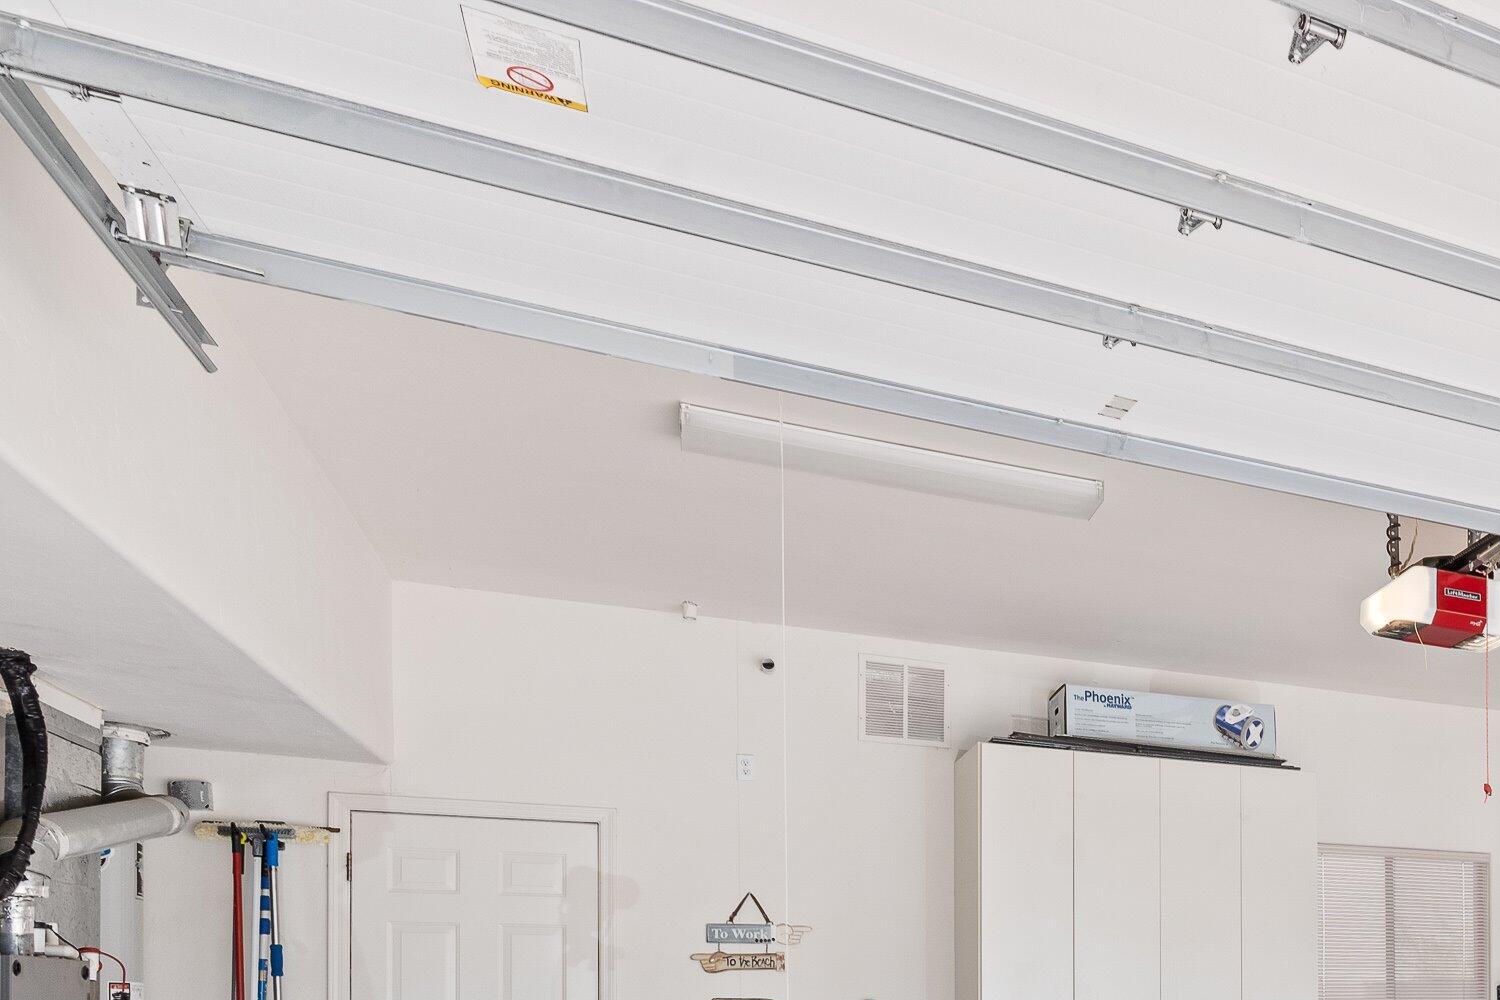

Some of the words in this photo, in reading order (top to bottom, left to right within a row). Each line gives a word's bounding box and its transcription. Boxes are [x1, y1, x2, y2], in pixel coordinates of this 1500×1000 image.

[489, 79, 557, 102] WARNING
[1447, 589, 1479, 600] LiftMaster
[1084, 690, 1131, 706] Phoenix
[711, 928, 729, 939] To
[731, 928, 769, 940] Work
[722, 956, 737, 967] To
